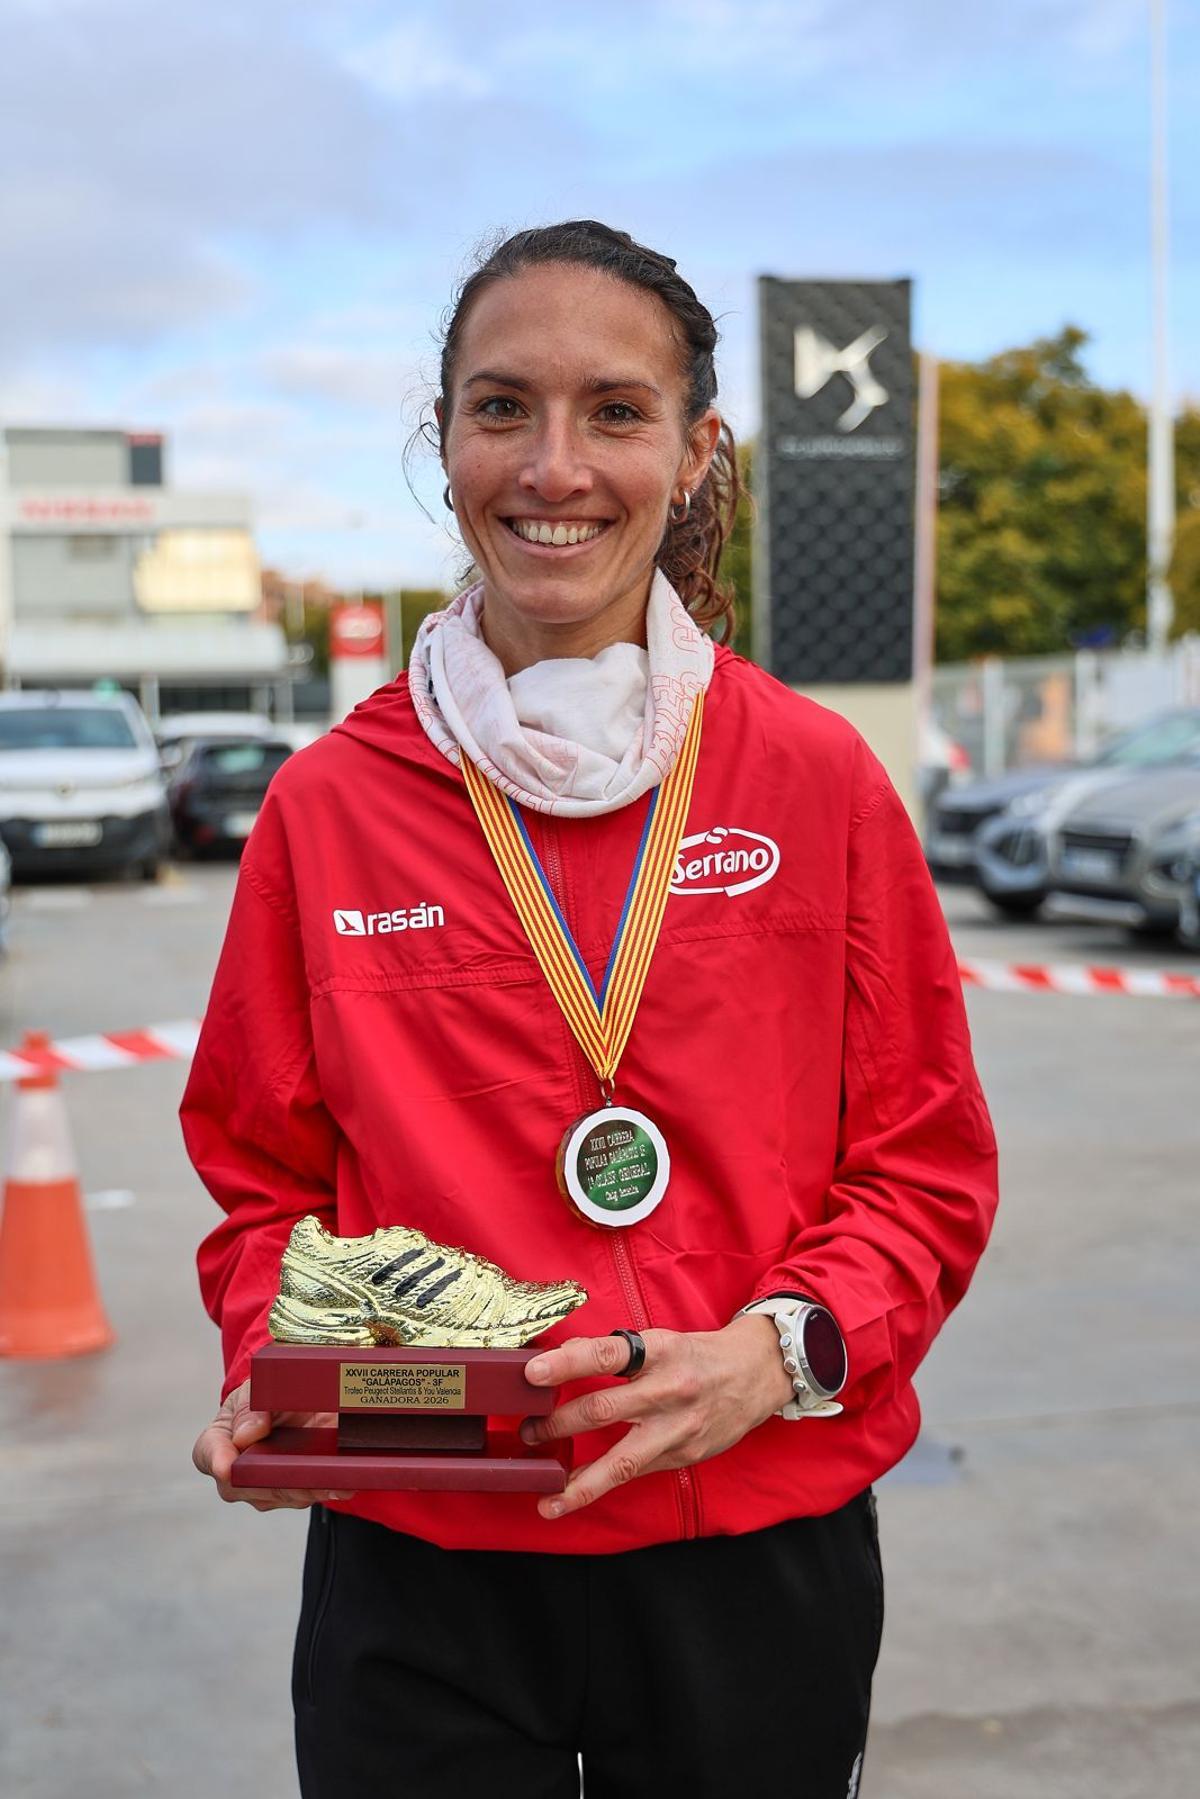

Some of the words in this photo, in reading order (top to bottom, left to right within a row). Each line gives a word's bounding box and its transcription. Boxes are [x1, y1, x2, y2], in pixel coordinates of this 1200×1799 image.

[671, 848, 769, 884] Serrano
[367, 902, 445, 935] rasán
[345, 1368, 369, 1377] XXVII
[370, 1369, 415, 1377] CARRERA
[416, 1369, 460, 1377] POPULAR
[432, 1378, 444, 1386] 3F
[424, 1387, 434, 1395] You
[360, 1396, 421, 1404] GANADORA
[423, 1396, 449, 1404] 2026
